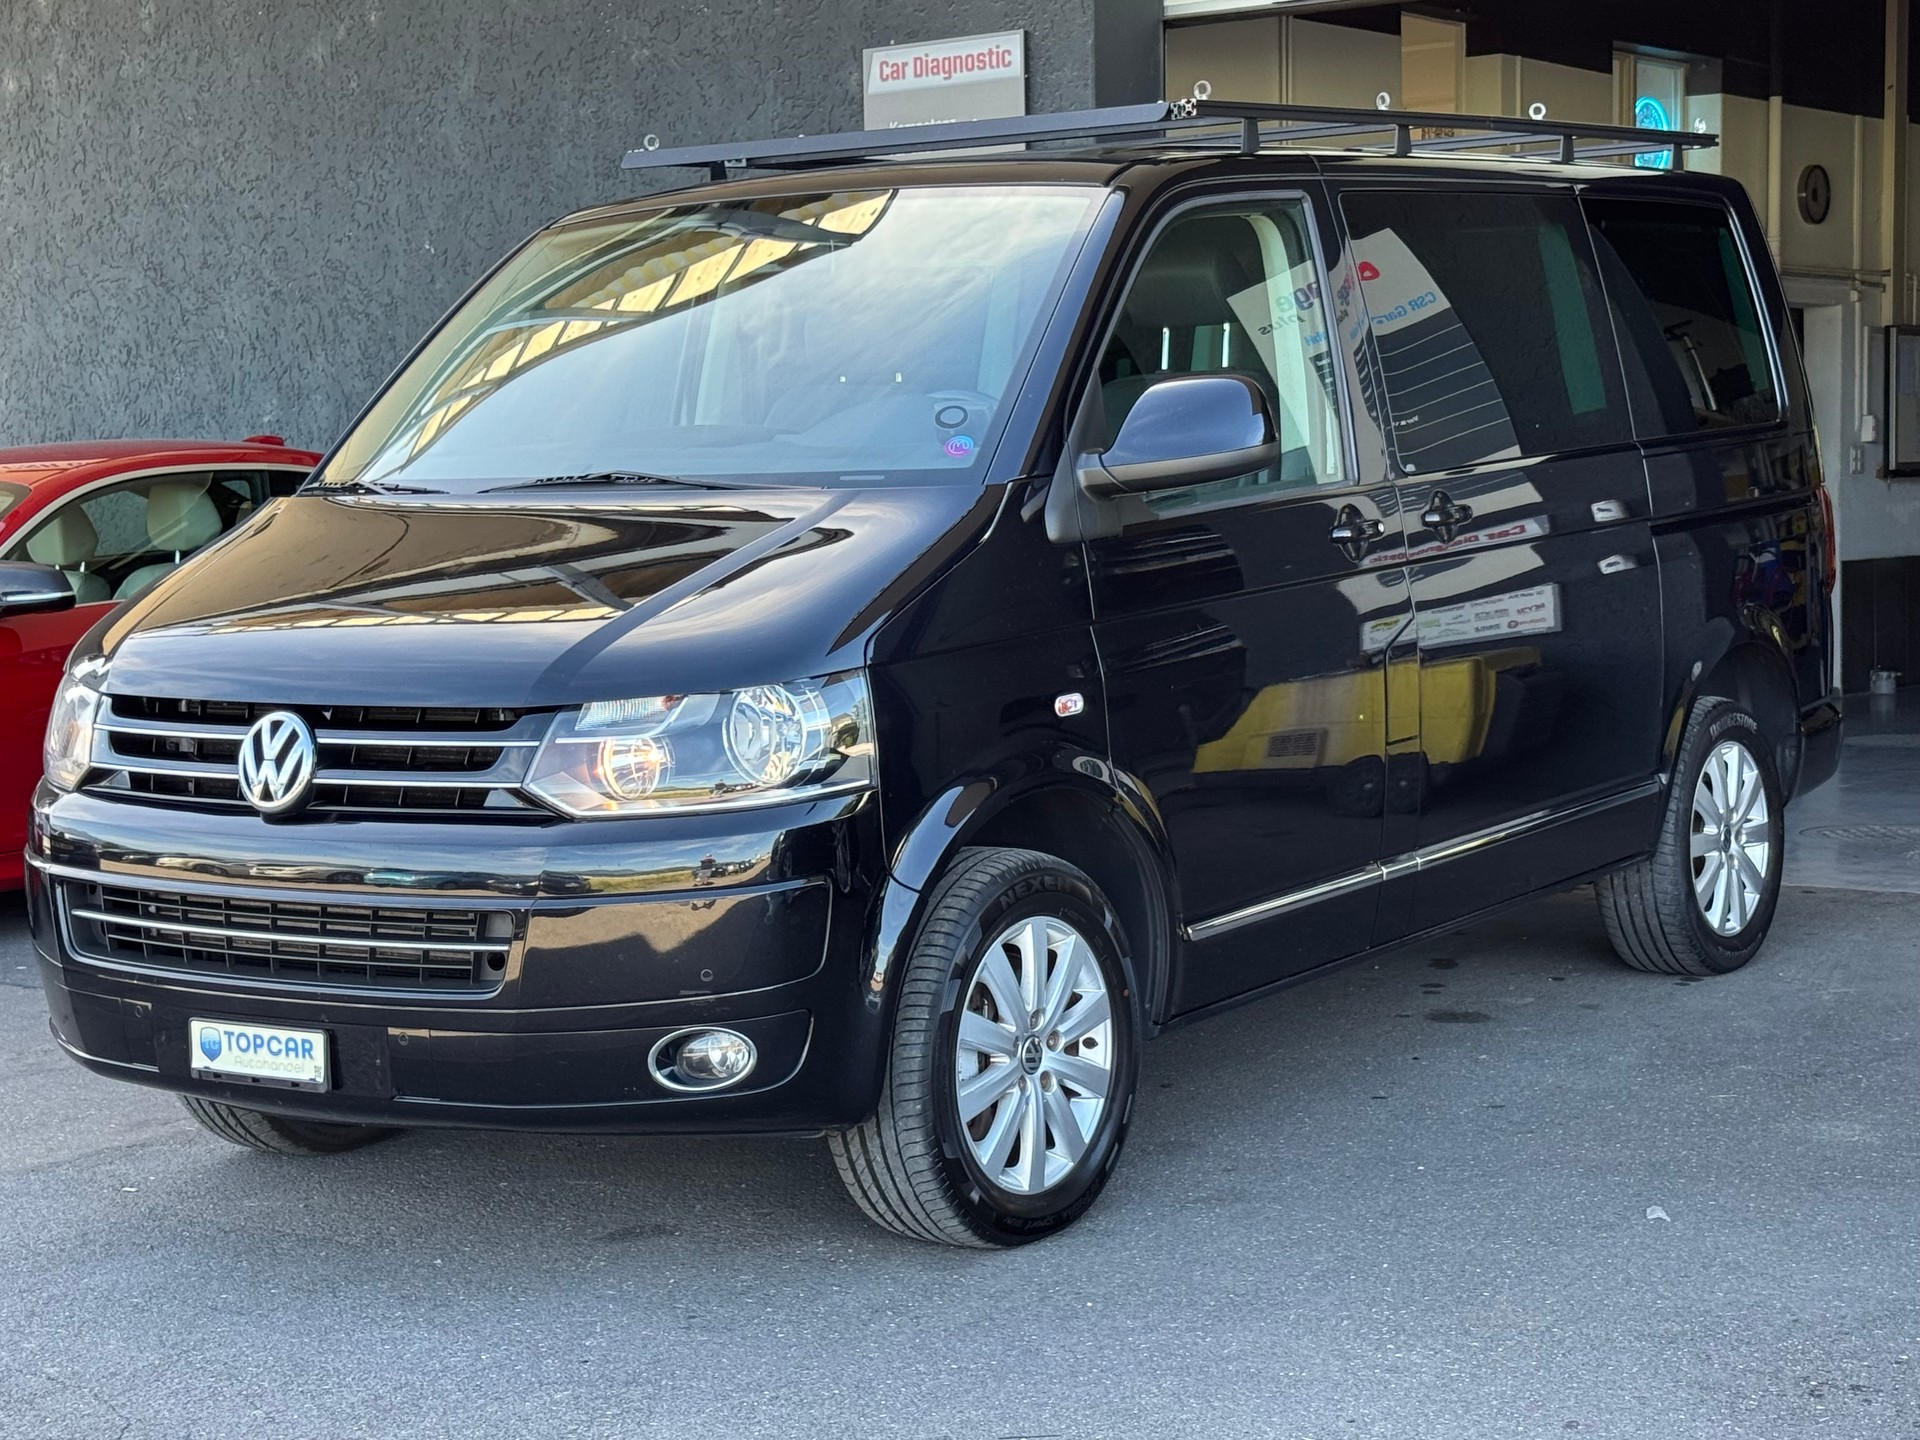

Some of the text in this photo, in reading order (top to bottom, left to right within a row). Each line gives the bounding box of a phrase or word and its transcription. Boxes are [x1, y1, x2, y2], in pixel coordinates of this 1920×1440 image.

[879, 45, 1012, 82] Car Diagnostic
[239, 711, 317, 814] VW
[223, 1030, 314, 1060] TOPCAR
[234, 1055, 305, 1074] Autohandel
